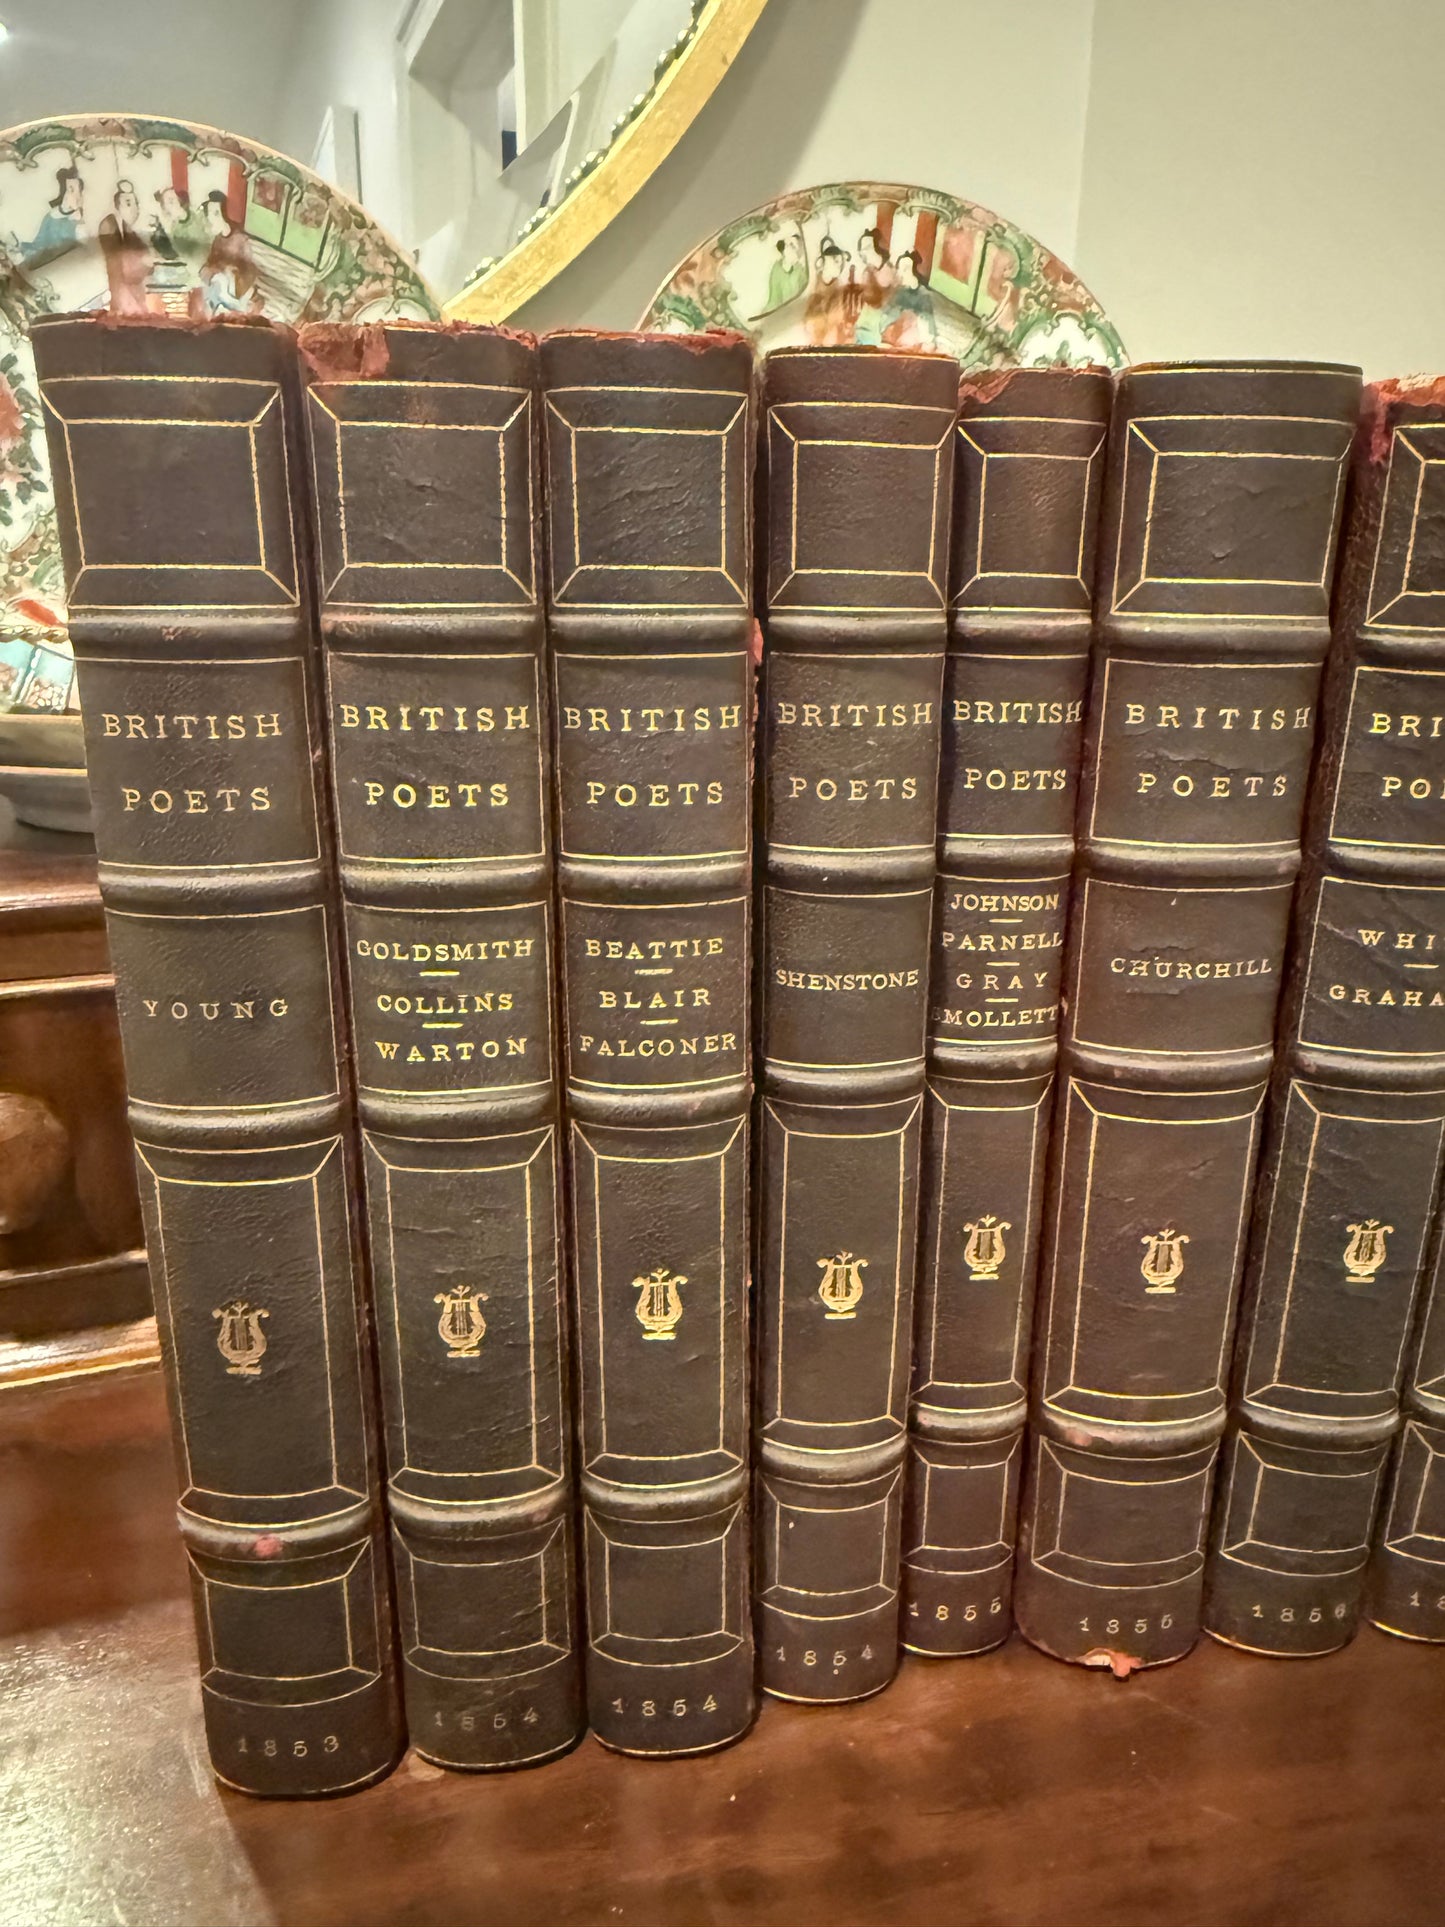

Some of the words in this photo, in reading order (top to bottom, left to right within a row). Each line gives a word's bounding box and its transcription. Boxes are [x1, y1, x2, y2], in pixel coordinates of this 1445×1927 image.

[340, 704, 530, 733] BRITISH
[563, 705, 741, 732] BRITISH
[778, 702, 933, 727] BRITISH
[952, 699, 1083, 725] BRITISH
[1125, 703, 1311, 730] BRITISH
[102, 711, 283, 740] BRITISH
[789, 776, 918, 801] POETS
[964, 767, 1067, 791] POETS
[1137, 772, 1288, 797] POETS
[1381, 776, 1445, 799] PO
[122, 786, 272, 814] POETS
[364, 781, 510, 808] POETS
[586, 781, 724, 807] POETS
[950, 893, 1059, 913] JOHNSON
[356, 939, 535, 962] GOLDSMITH
[585, 937, 724, 960] BEATTIE
[941, 931, 1063, 952] PARNELL
[774, 968, 920, 991] SHENSTONE
[1110, 956, 1273, 980] CHURCHILL
[956, 972, 1048, 991] GRAY
[142, 999, 289, 1020] YOUNG
[376, 993, 514, 1014] COLLINS
[599, 989, 712, 1009] BLAIR
[374, 1037, 528, 1063] WARTON
[579, 1032, 738, 1057] FALCONER
